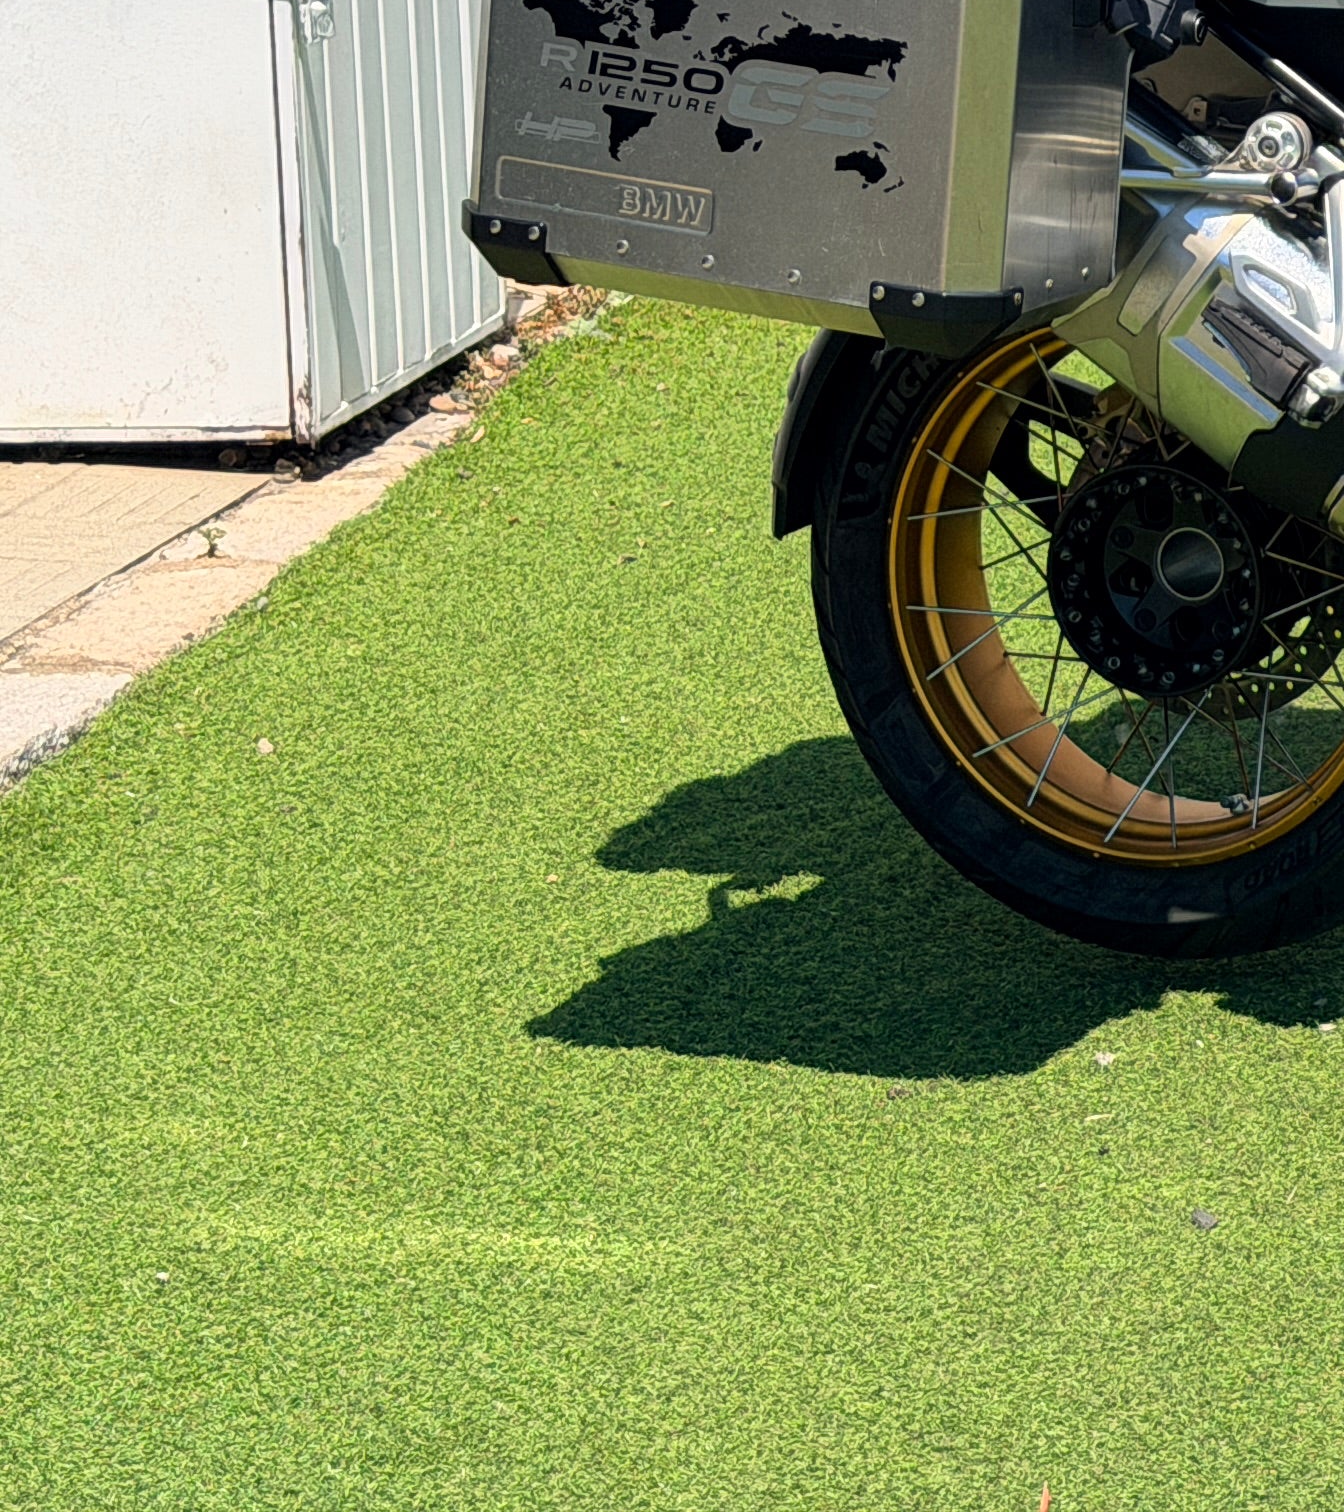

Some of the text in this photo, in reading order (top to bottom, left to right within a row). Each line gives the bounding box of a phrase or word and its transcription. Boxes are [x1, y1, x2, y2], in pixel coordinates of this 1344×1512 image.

[558, 76, 717, 116] ADVENTURE
[617, 184, 707, 228] BMW
[864, 353, 940, 455] MICH
